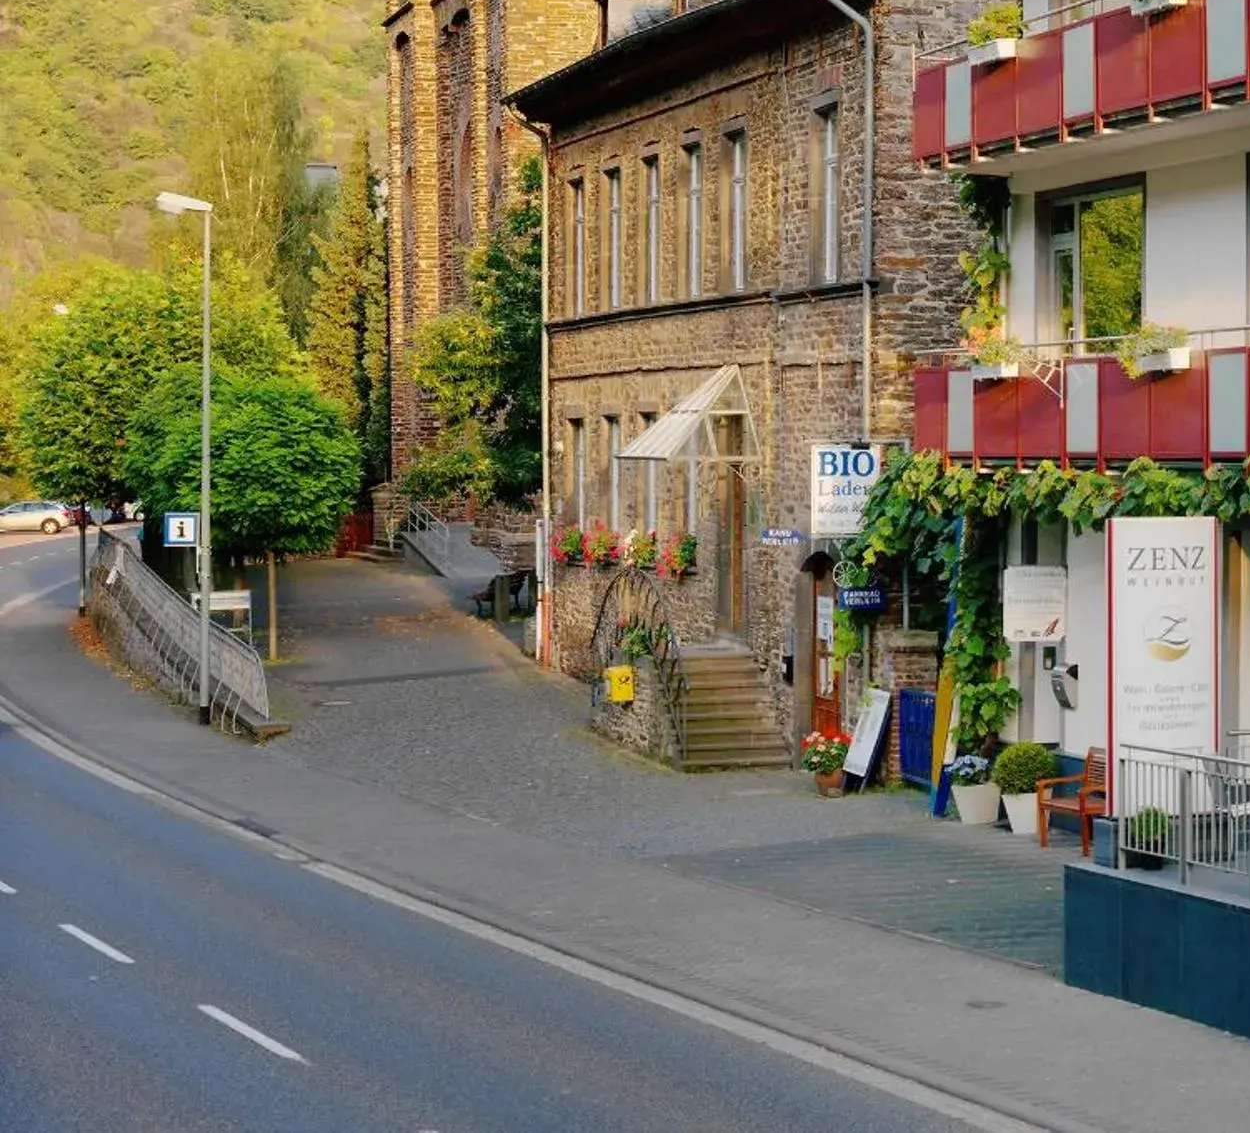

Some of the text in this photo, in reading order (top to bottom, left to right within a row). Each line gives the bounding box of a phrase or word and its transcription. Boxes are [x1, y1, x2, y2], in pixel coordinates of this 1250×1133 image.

[818, 450, 875, 477] BIO
[1128, 546, 1205, 571] ZENZ
[1127, 575, 1204, 587] WEINGUT
